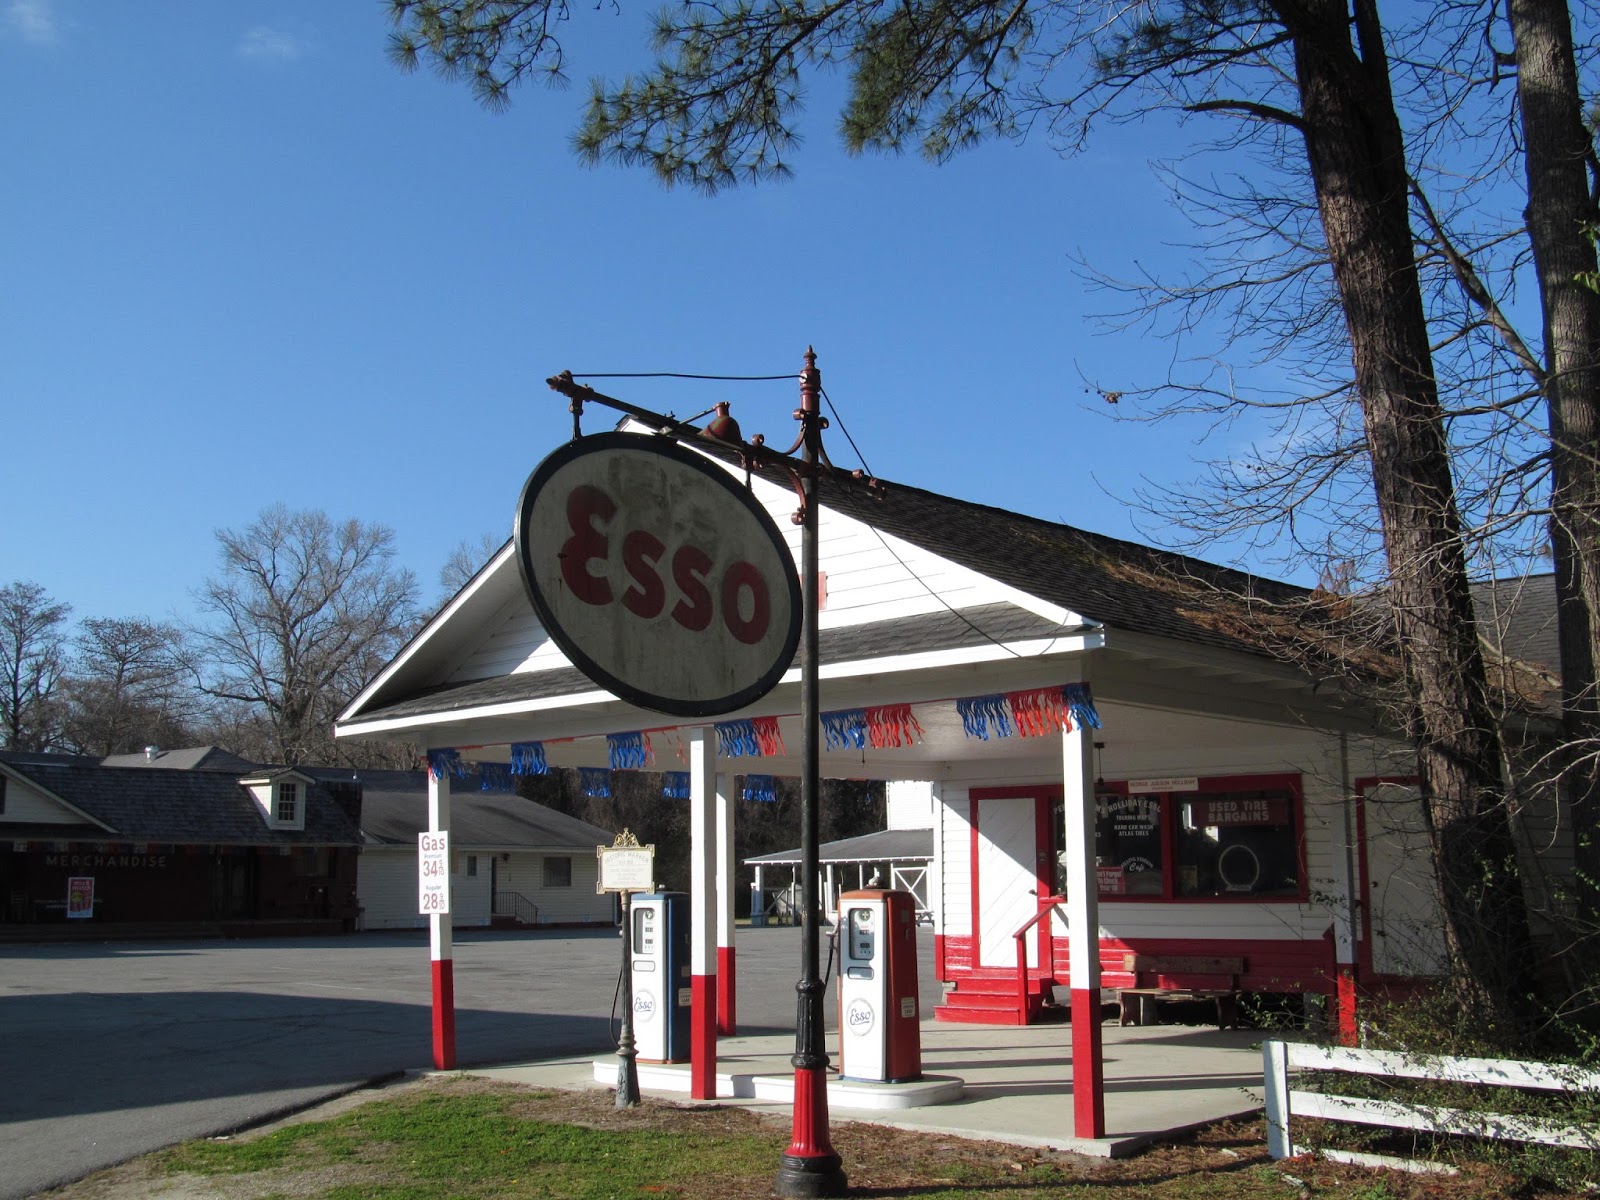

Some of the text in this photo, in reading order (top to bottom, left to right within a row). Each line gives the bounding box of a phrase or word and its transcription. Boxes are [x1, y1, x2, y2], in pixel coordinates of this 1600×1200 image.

[560, 485, 770, 645] ESSO
[1107, 799, 1142, 813] HOLLIDAY
[1208, 800, 1268, 812] USED TIRE
[1208, 810, 1270, 823] BARGAINS
[421, 835, 446, 851] Gas
[46, 855, 167, 868] MERCHANDISE
[423, 861, 438, 877] 34
[423, 893, 438, 910] 28
[634, 997, 653, 1012] Esso
[849, 1008, 871, 1026] Esso
